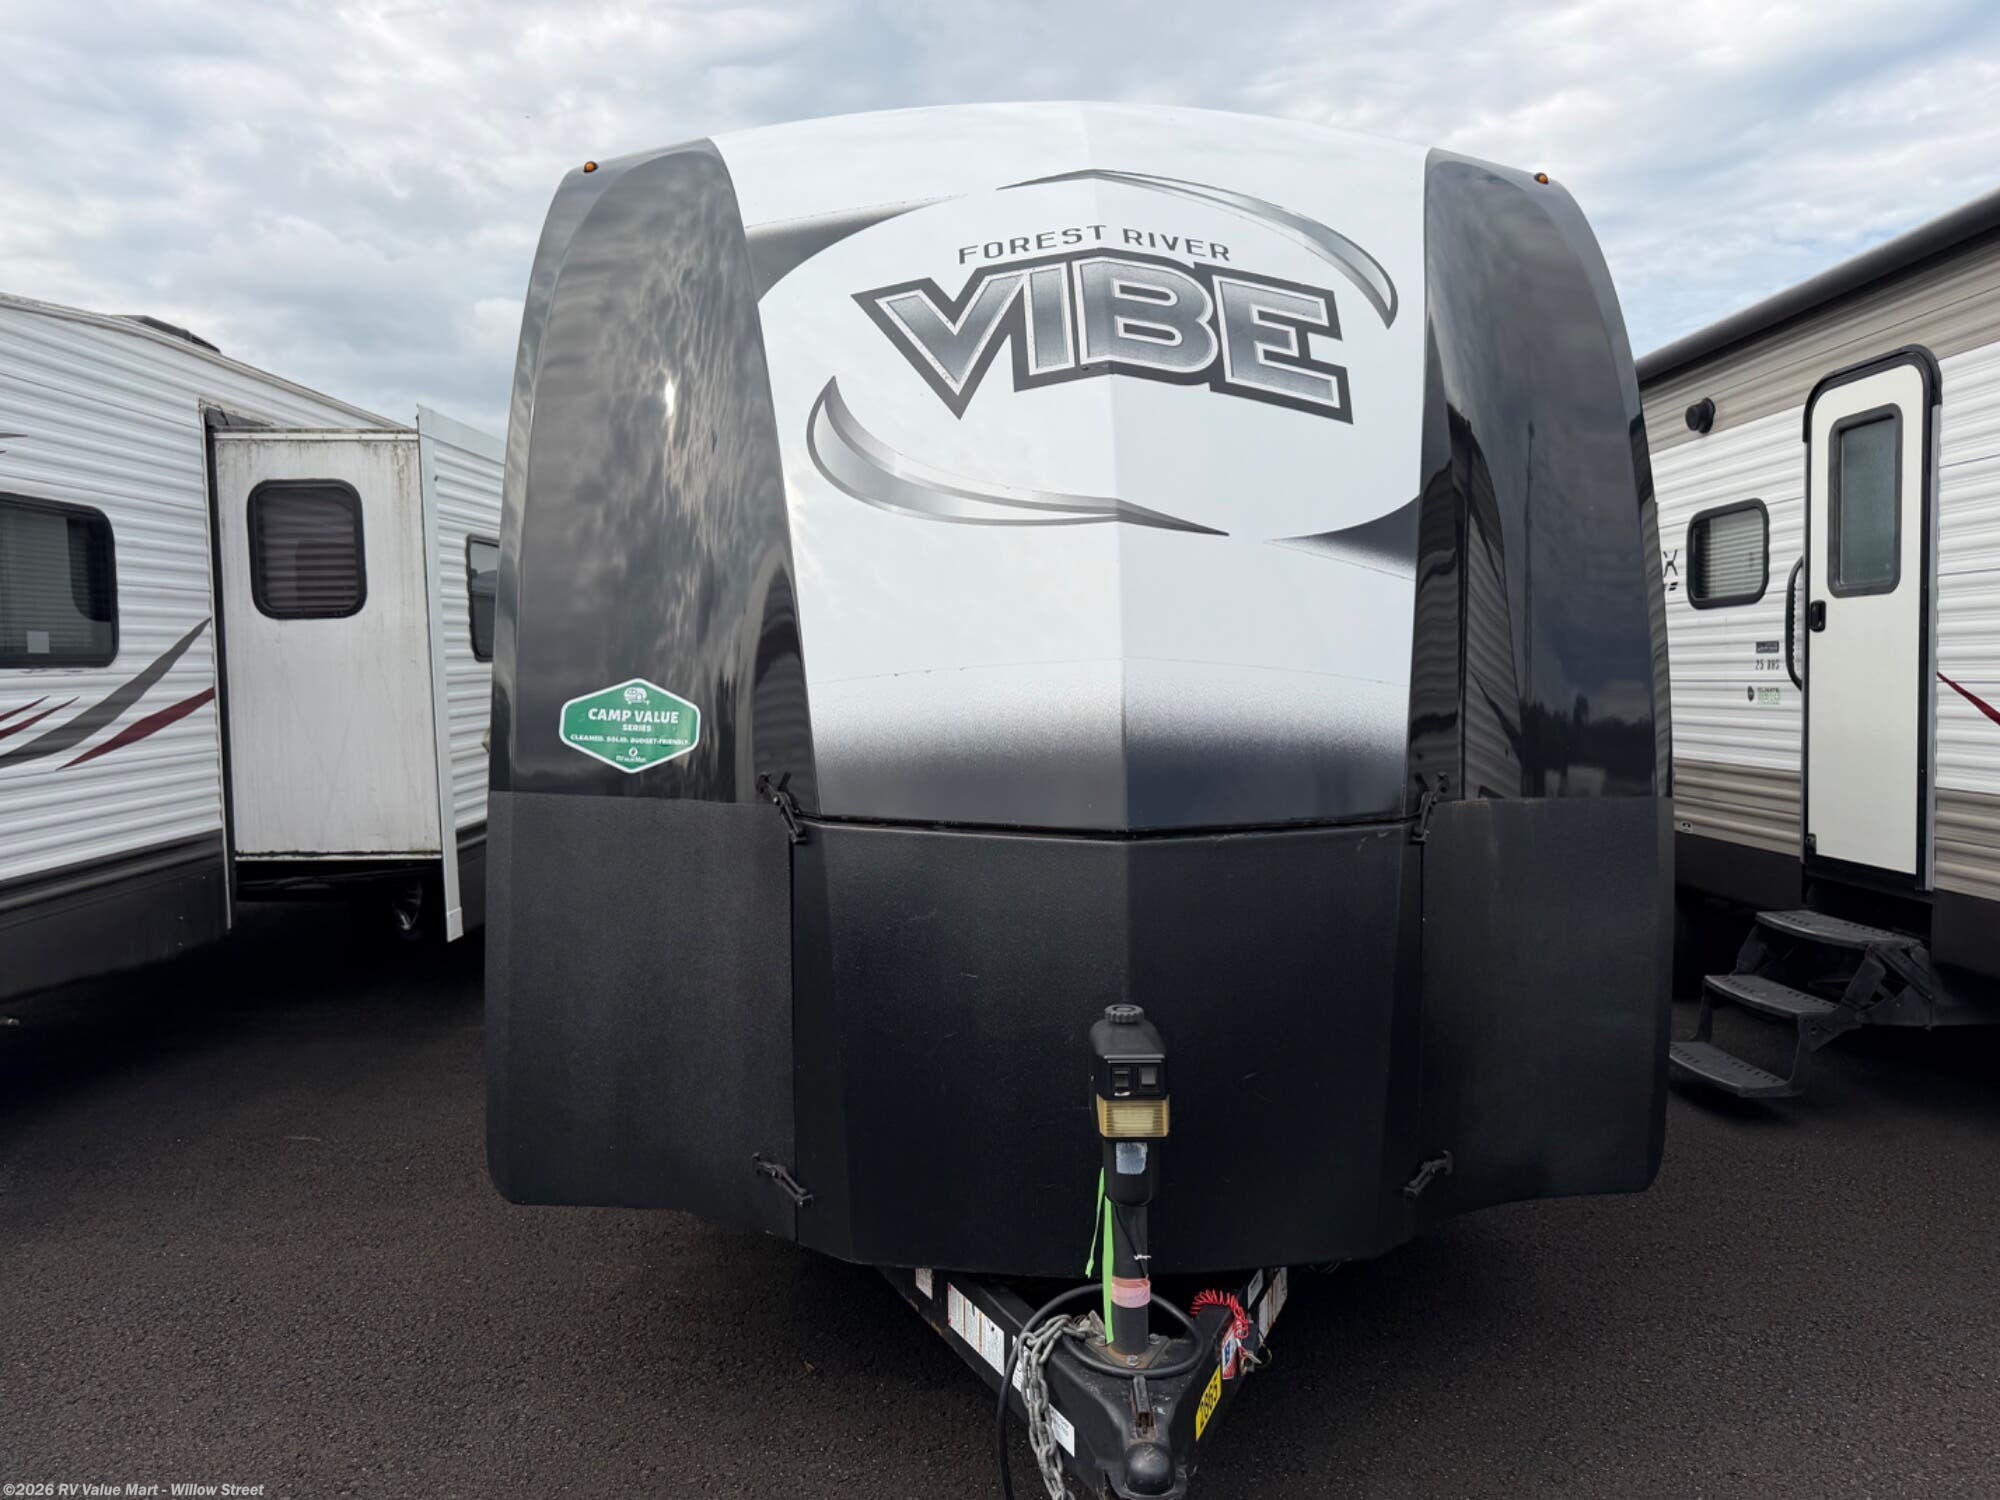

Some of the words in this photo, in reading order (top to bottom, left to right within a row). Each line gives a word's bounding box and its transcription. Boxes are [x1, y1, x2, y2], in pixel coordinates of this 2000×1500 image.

[958, 224, 1107, 265] FOREST
[1121, 227, 1230, 262] RIVER
[850, 248, 1354, 426] VIBE
[588, 708, 631, 722] CAMP
[634, 710, 679, 724] VALUE
[622, 723, 652, 732] SERIES
